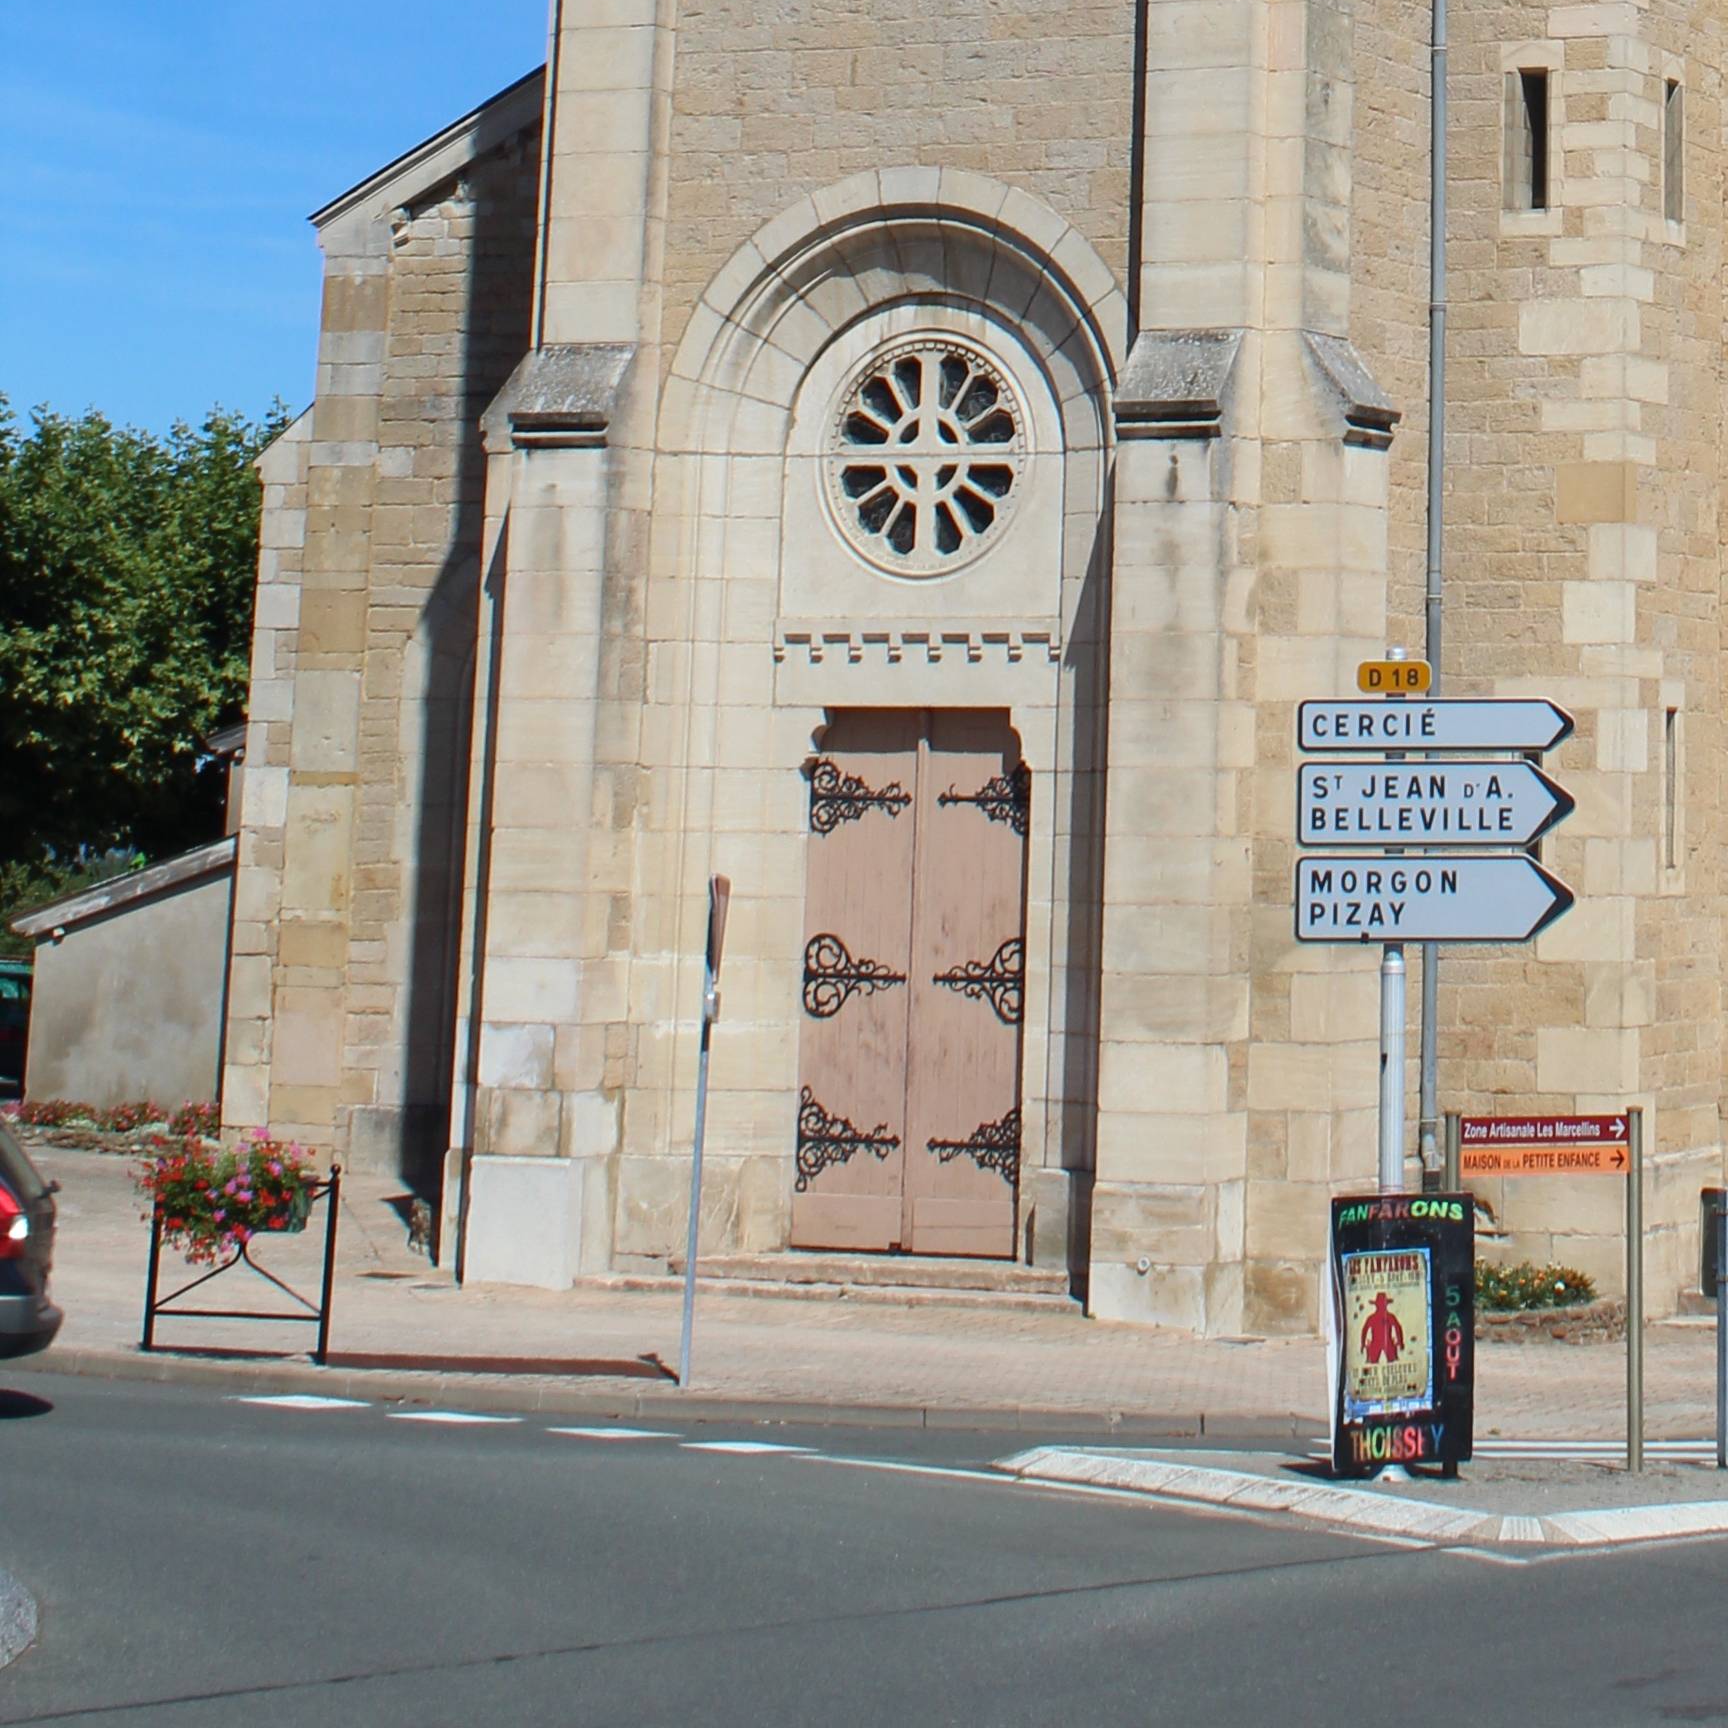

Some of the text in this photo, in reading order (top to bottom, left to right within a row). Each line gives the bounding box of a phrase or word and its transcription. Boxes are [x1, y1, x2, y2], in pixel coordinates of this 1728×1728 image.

[1369, 668, 1419, 687] D 18
[1312, 707, 1436, 737] CERCIÉ
[1362, 775, 1446, 799] JEAN
[1311, 807, 1514, 831] BELLEVILLE
[1310, 870, 1457, 894] MORGON
[1309, 902, 1406, 926] PIZAY
[1463, 1121, 1600, 1139] Zone Artisanale Les Marcellins
[1463, 1153, 1501, 1170] MAISON
[1503, 1159, 1512, 1169] DE
[1522, 1153, 1556, 1169] PETITE
[1557, 1152, 1600, 1168] ENFANCE
[1339, 1200, 1463, 1229] FANFARONS
[1445, 1286, 1460, 1306] 5
